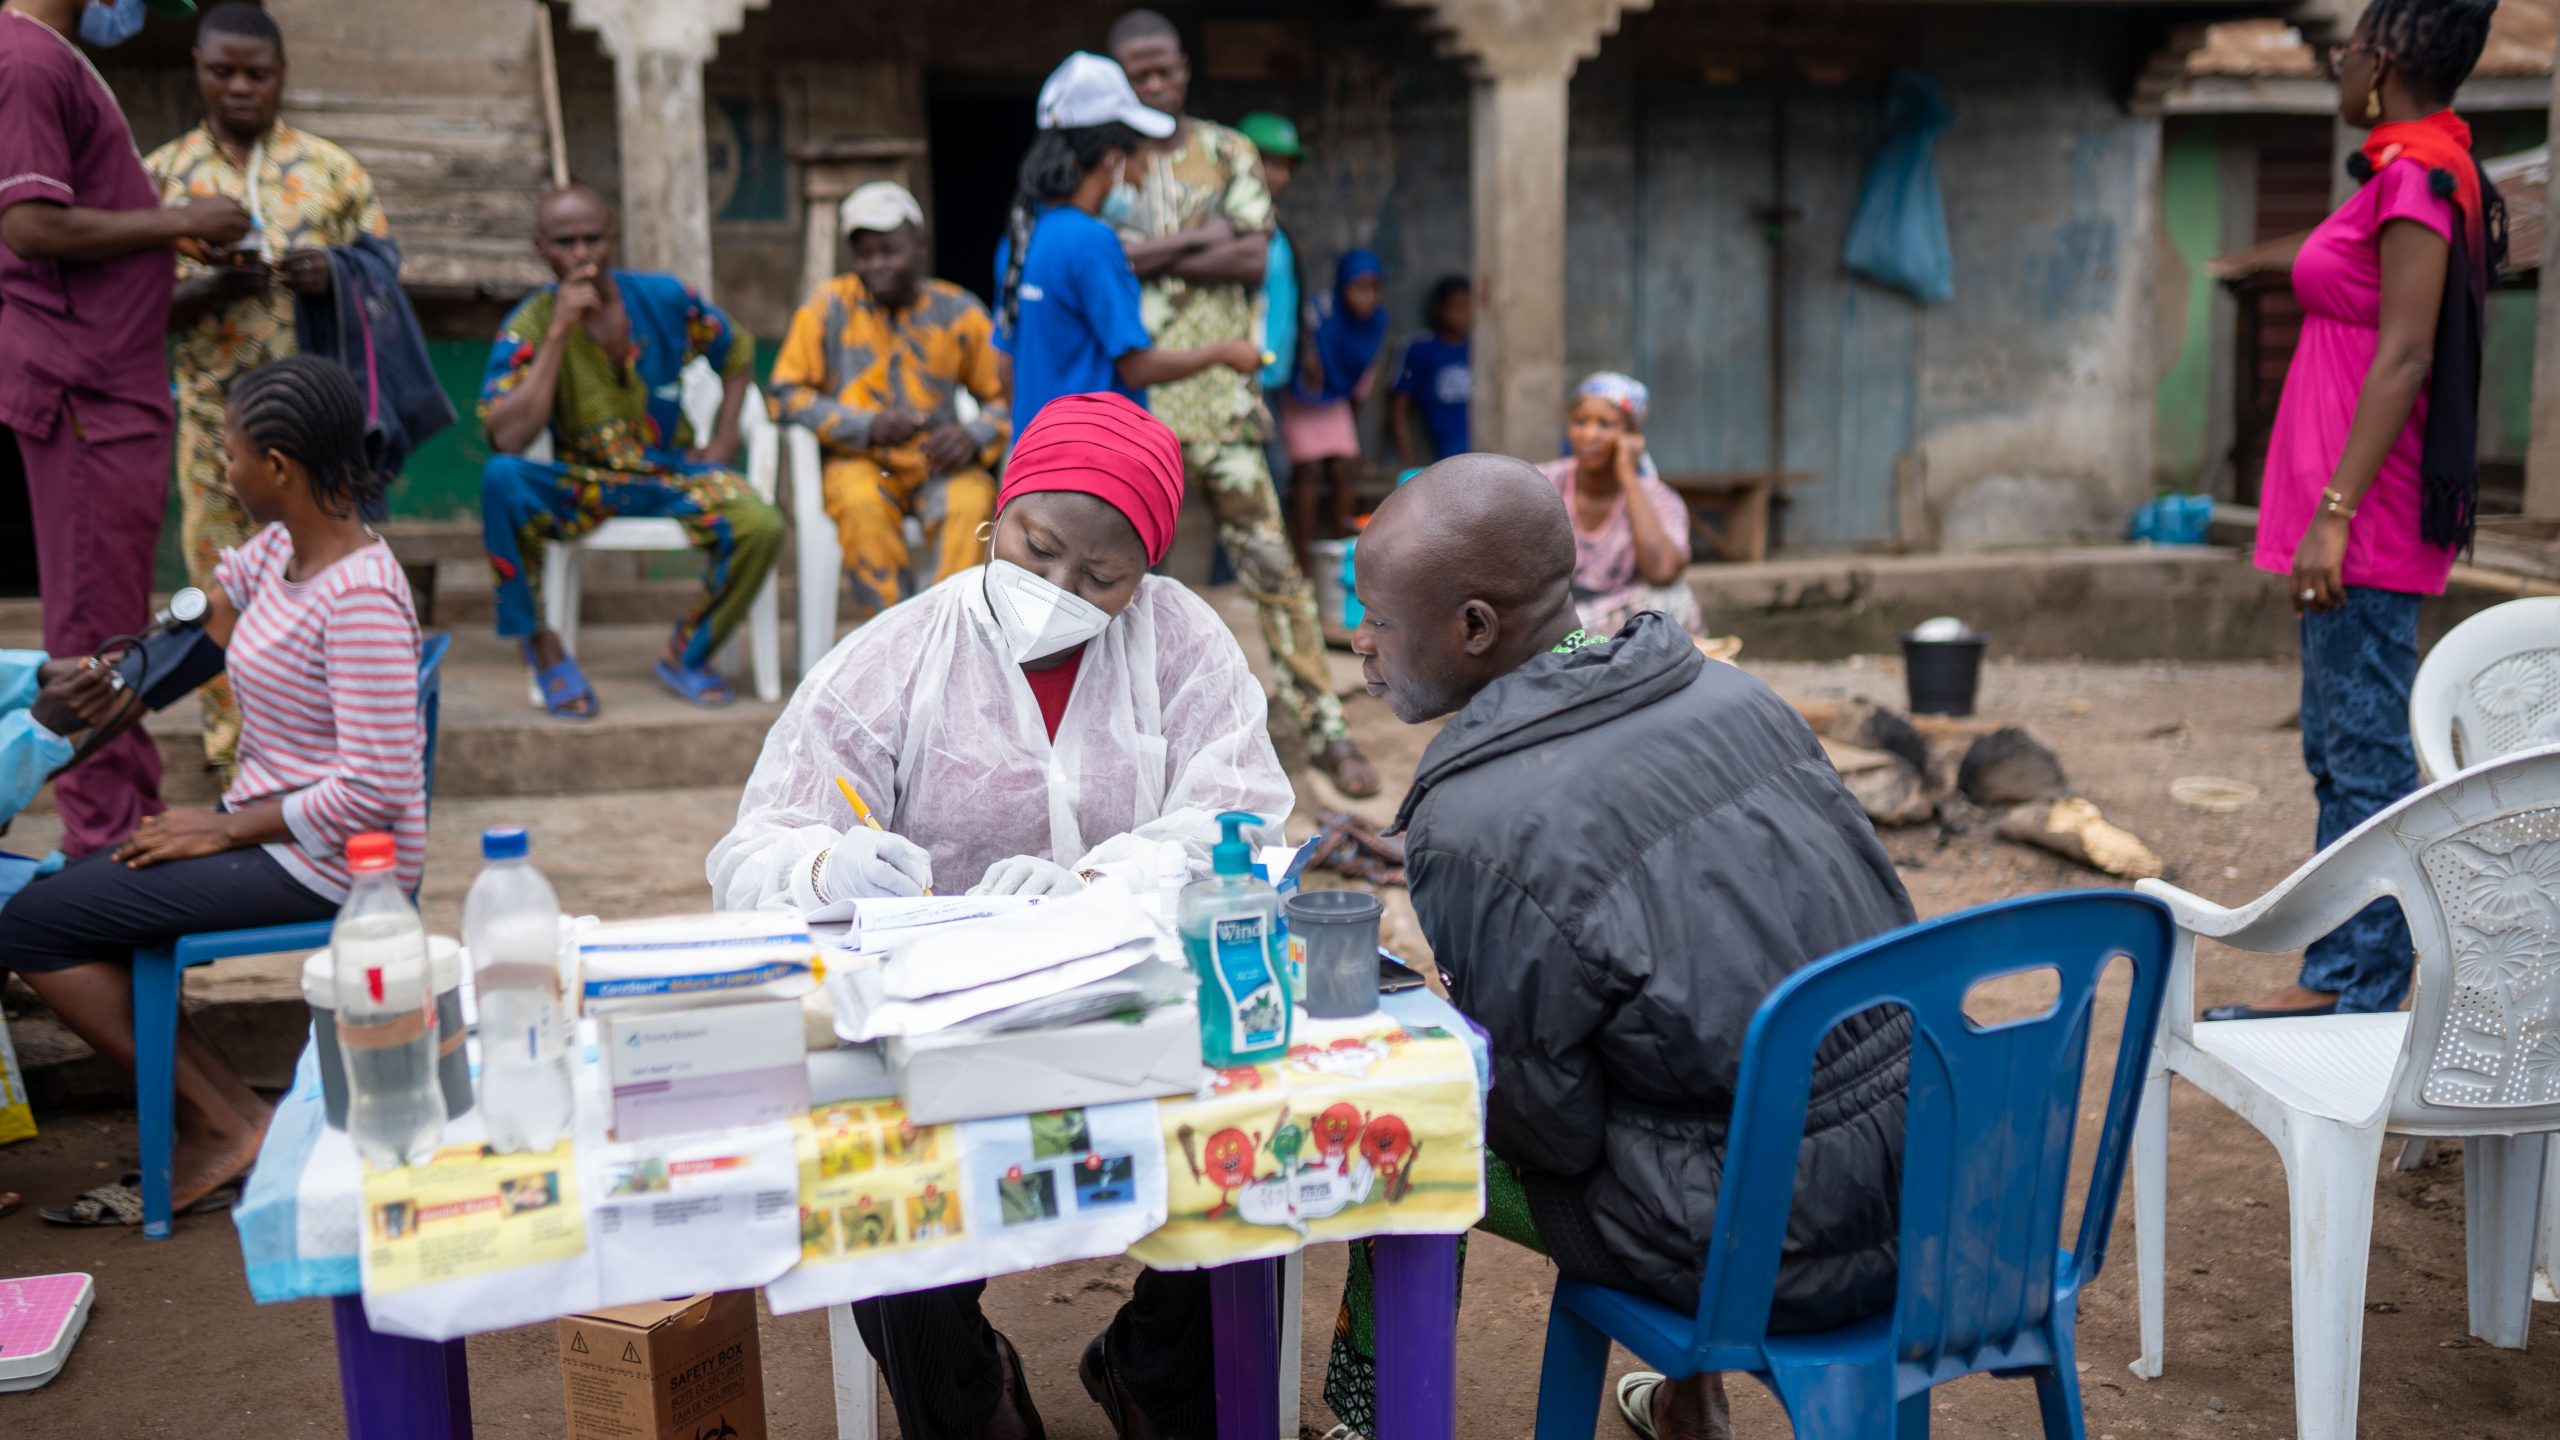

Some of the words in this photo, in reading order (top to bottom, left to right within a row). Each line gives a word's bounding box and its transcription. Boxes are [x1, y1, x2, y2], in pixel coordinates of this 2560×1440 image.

[1380, 1152, 1398, 1164] HIV
[1225, 1174, 1244, 1186] HIV
[670, 1356, 715, 1391] SAFETY
[719, 1342, 743, 1365] BOX
